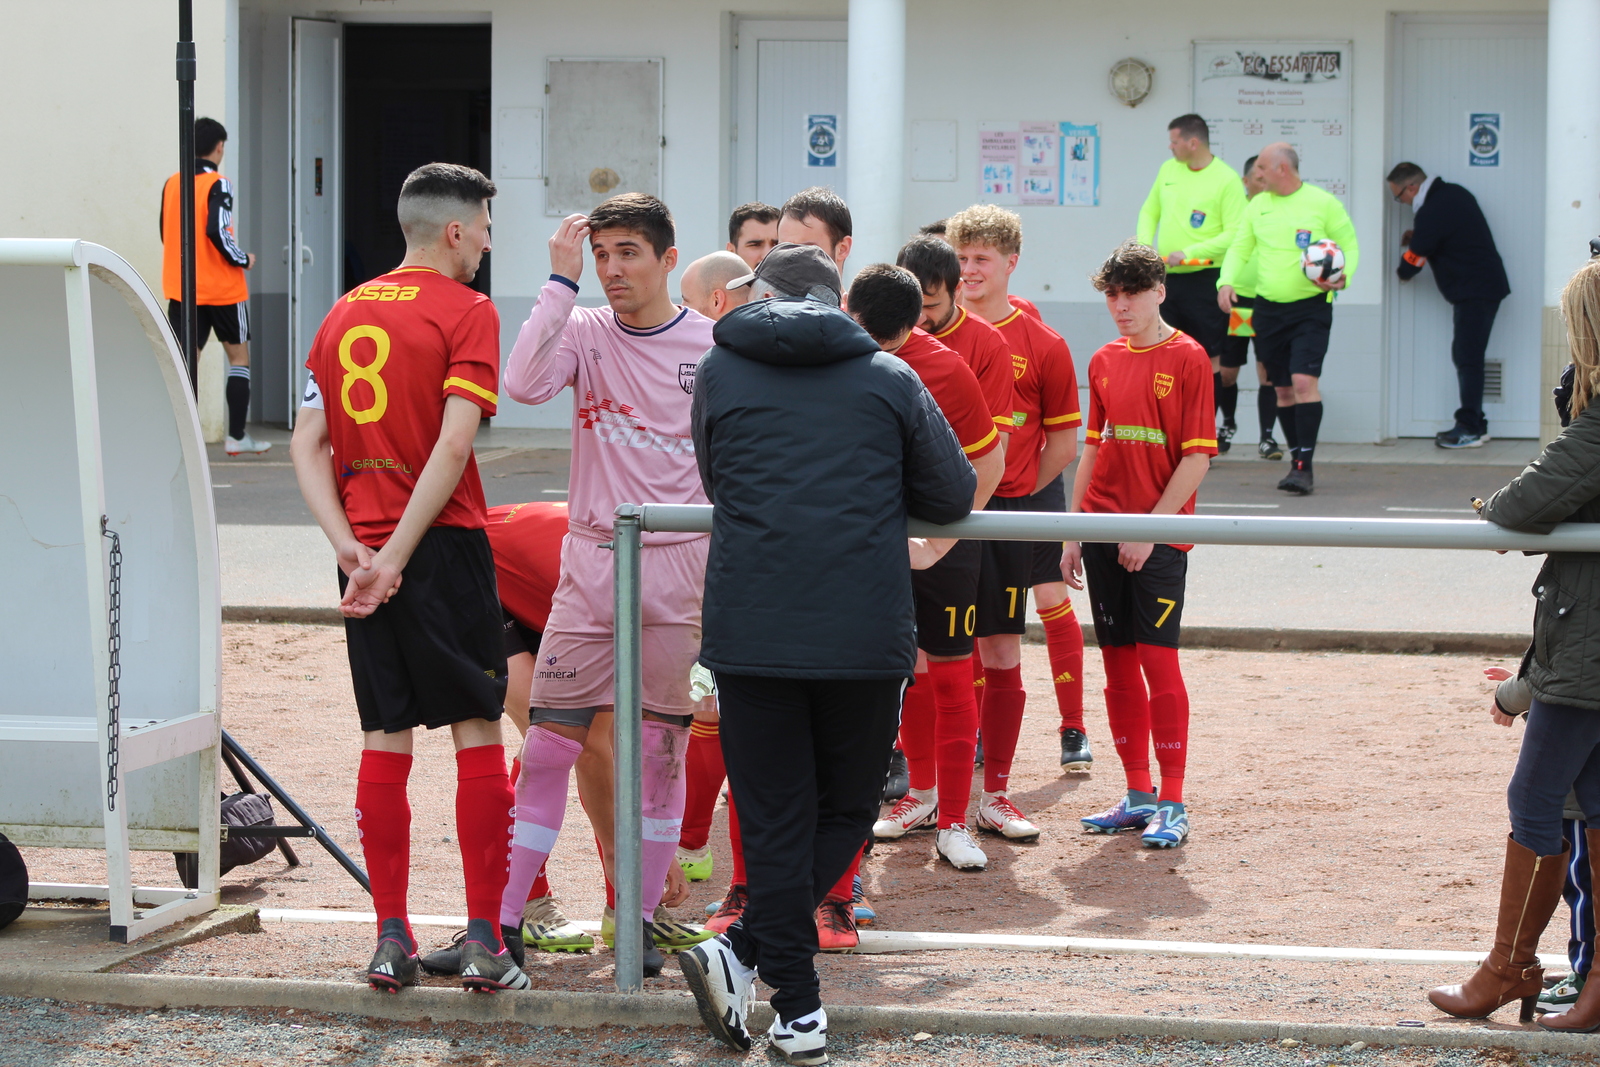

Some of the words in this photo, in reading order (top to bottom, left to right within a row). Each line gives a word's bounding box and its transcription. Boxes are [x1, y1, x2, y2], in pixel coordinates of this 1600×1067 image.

[1268, 54, 1338, 74] ESSARTAIS
[1238, 88, 1264, 96] Planning
[1265, 88, 1276, 96] des
[338, 324, 391, 425] 8
[598, 410, 641, 428] GARAGE
[944, 603, 976, 638] 10
[1154, 597, 1177, 629] 7
[1155, 741, 1182, 750] JAKO
